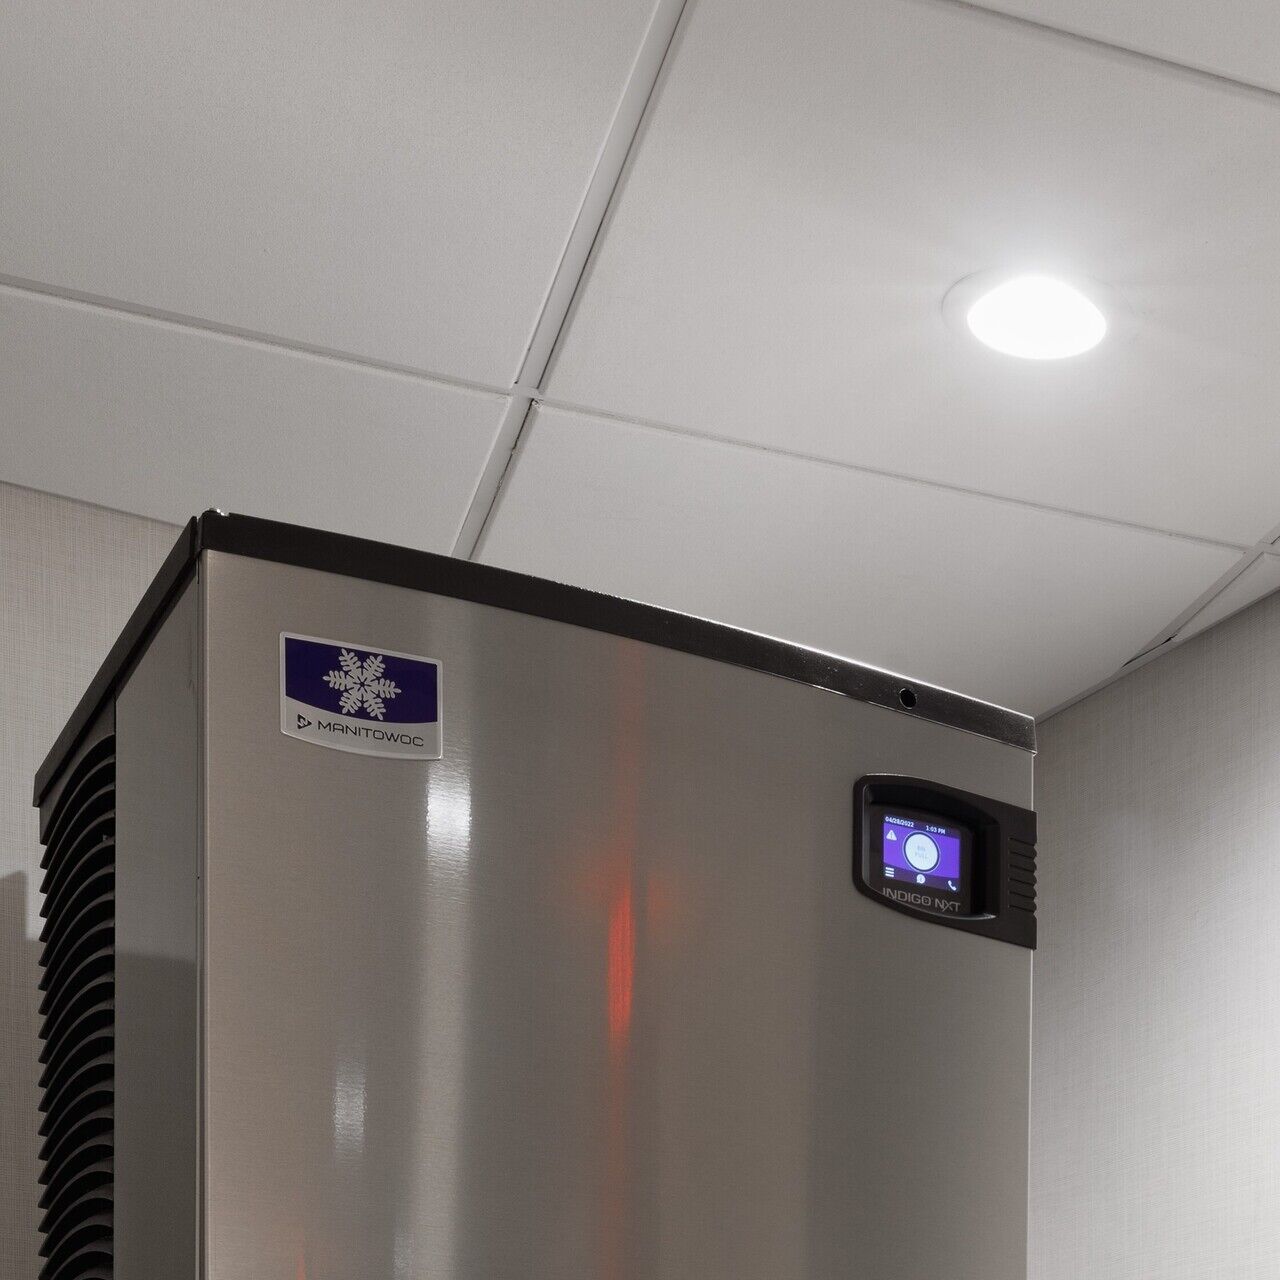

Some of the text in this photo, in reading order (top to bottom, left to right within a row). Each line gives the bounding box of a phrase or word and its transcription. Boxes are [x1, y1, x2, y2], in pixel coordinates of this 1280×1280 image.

[317, 720, 424, 747] MANITOWOC
[882, 887, 961, 913] INDIGO NXT
